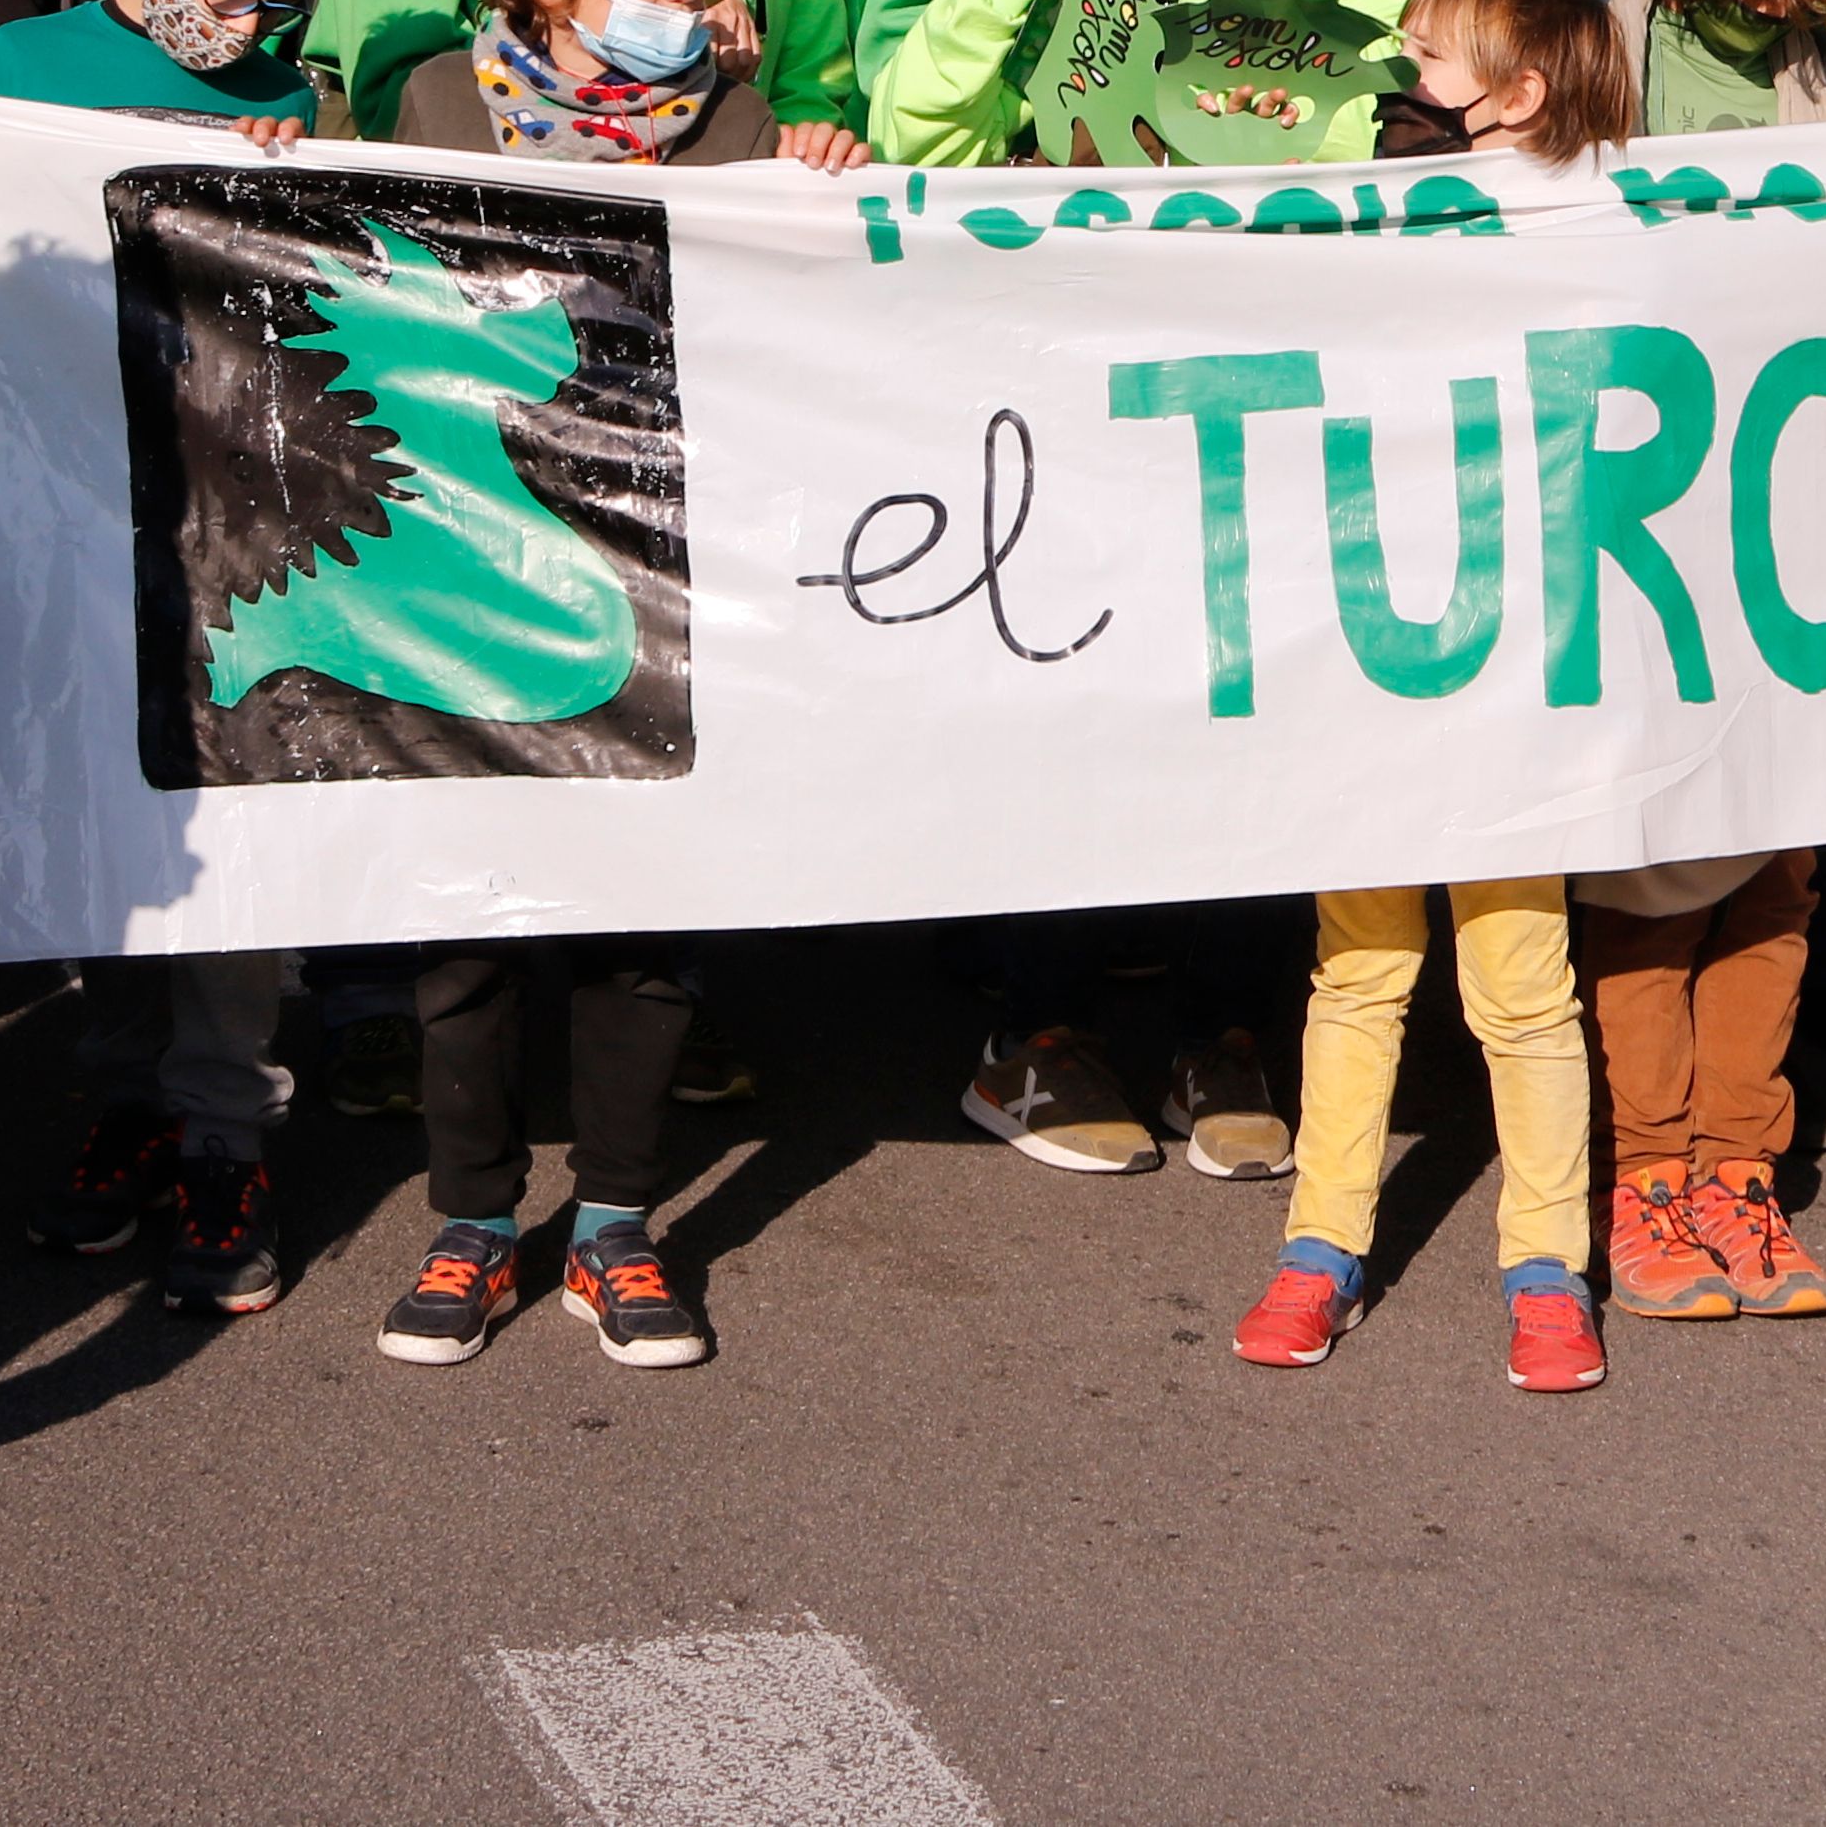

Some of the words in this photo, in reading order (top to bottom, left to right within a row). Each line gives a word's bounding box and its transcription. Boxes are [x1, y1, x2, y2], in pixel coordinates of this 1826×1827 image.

[1176, 5, 1299, 46] som
[1195, 31, 1355, 78] escola
[799, 407, 1112, 663] el
